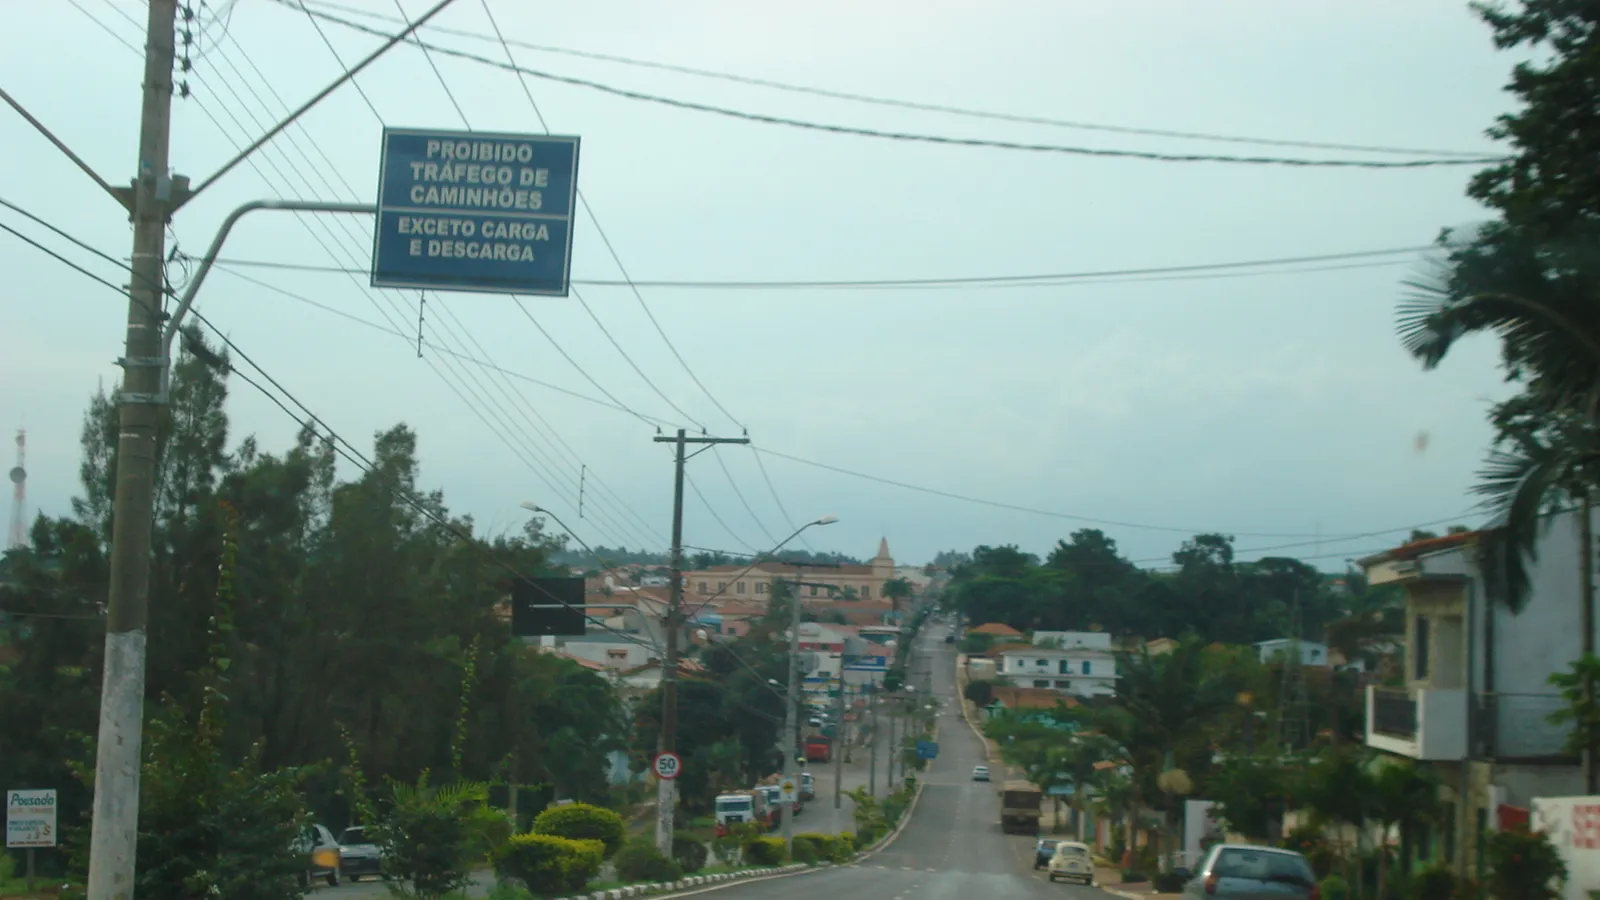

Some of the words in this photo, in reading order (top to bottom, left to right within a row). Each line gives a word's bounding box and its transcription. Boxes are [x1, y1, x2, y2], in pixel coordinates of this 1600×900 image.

[427, 140, 532, 162] PROIBIDO
[410, 161, 513, 183] TRÁFEGO
[519, 168, 549, 187] DE
[410, 184, 542, 209] CAMINHÕES
[398, 217, 475, 236] EXCETO
[481, 221, 549, 240] CARGA
[409, 239, 421, 256] E
[428, 240, 534, 262] DESCARGA
[659, 758, 675, 769] 50
